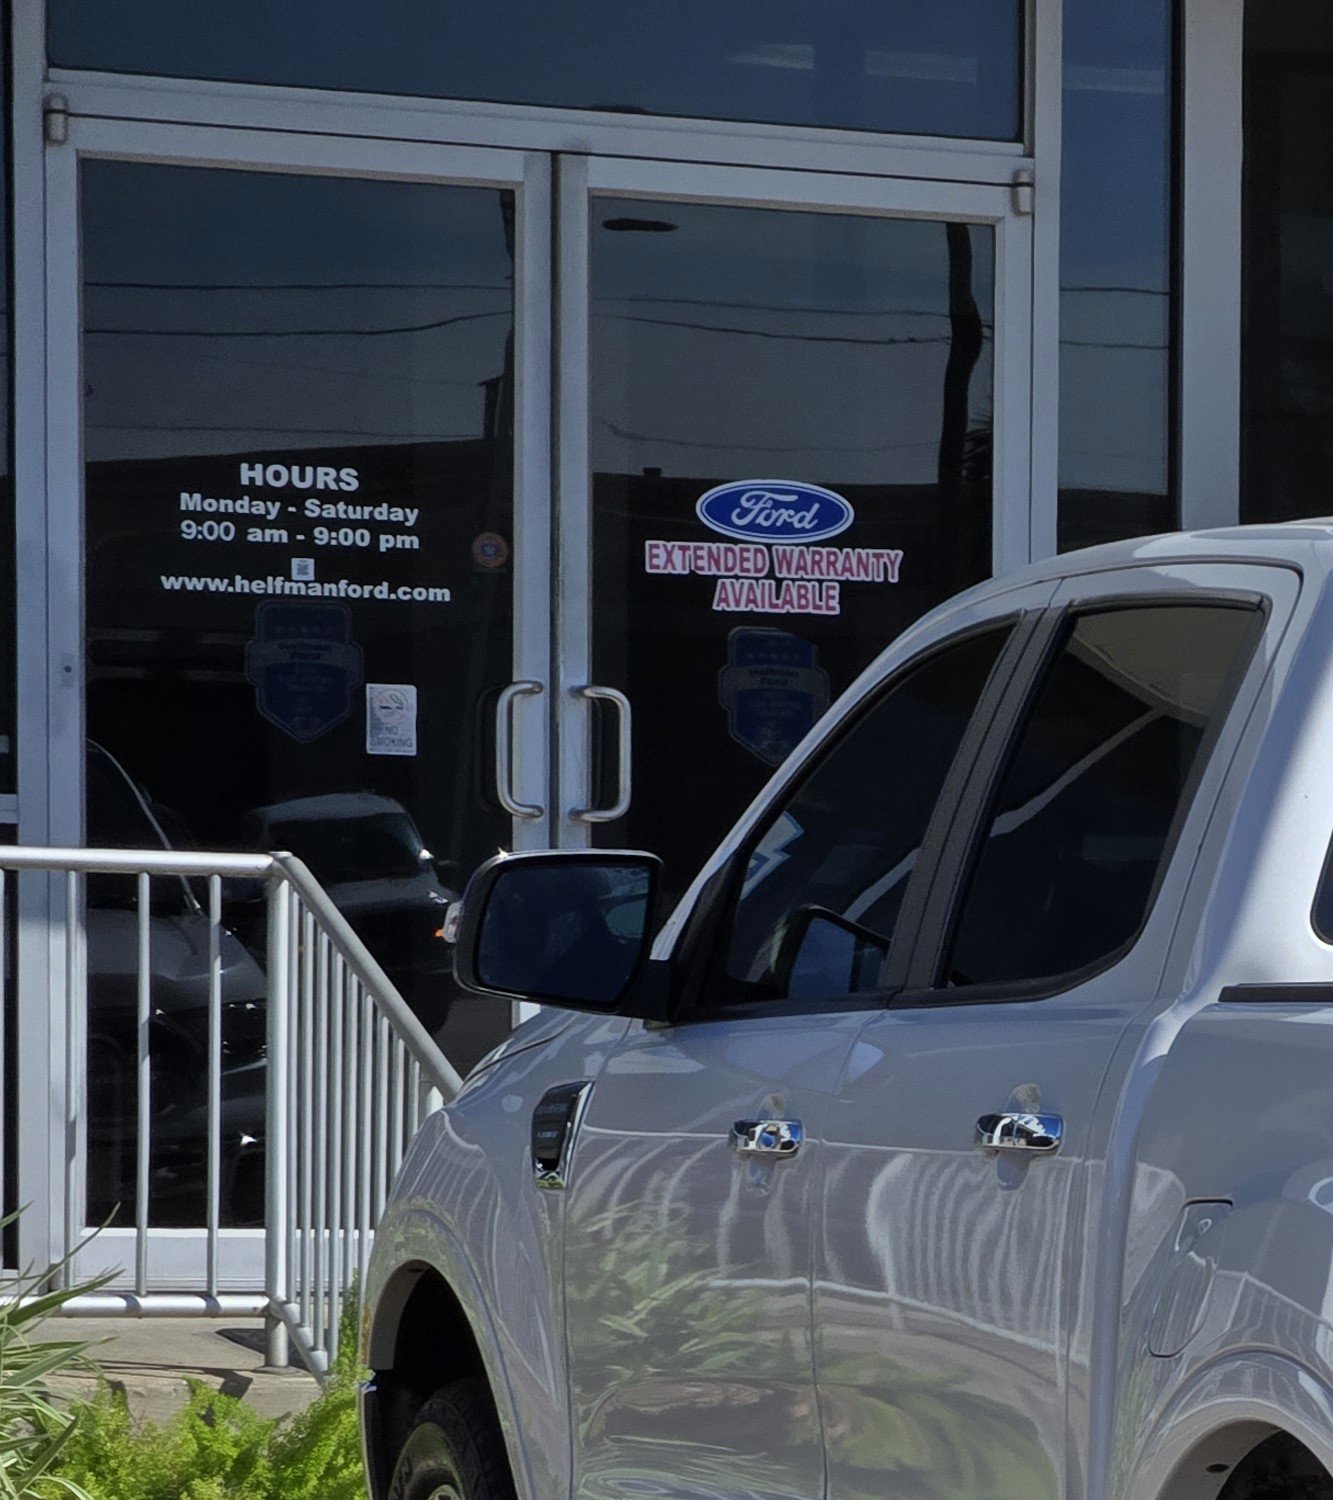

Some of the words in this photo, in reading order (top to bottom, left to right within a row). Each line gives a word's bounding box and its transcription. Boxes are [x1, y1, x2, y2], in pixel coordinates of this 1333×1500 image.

[240, 463, 359, 491] HOURS
[180, 492, 282, 519] Monday
[304, 499, 419, 526] Saturday
[731, 490, 818, 530] Ford
[181, 520, 236, 542] 9:00
[247, 527, 288, 544] am
[313, 528, 370, 549] 9:00
[379, 534, 420, 553] pm
[648, 543, 767, 573] EXTENDED
[775, 549, 902, 581] WARRANTY
[161, 573, 451, 603] www.helfmanford.com
[715, 581, 839, 613] AVAILABLE
